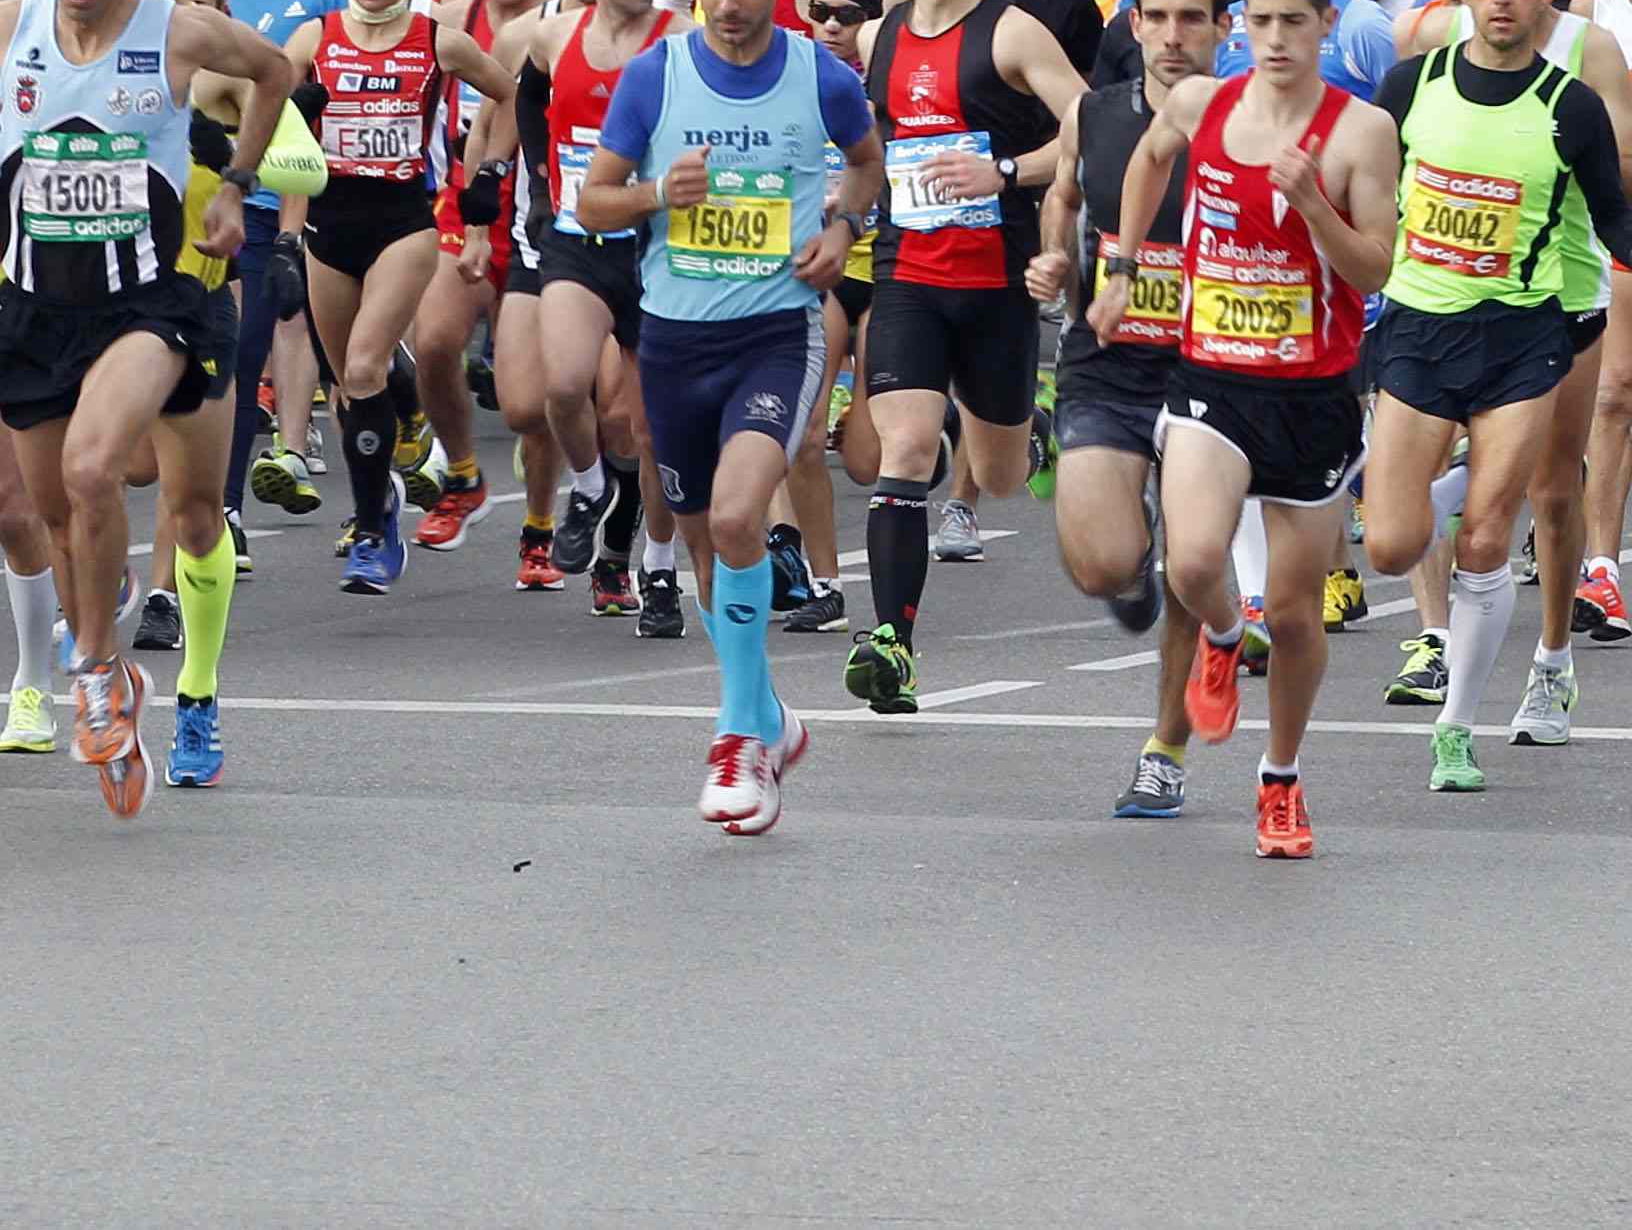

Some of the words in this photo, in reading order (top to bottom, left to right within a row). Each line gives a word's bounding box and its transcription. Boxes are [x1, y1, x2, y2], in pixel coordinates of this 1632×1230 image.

[367, 77, 396, 90] BM
[363, 98, 419, 114] adidas
[683, 125, 773, 153] nerja
[41, 173, 123, 212] 15001
[1448, 178, 1517, 200] adidas
[73, 218, 145, 236] adidas
[687, 206, 769, 249] 15049
[1423, 200, 1499, 247] 20042
[1234, 263, 1306, 284] adidas
[1215, 294, 1292, 333] 20025
